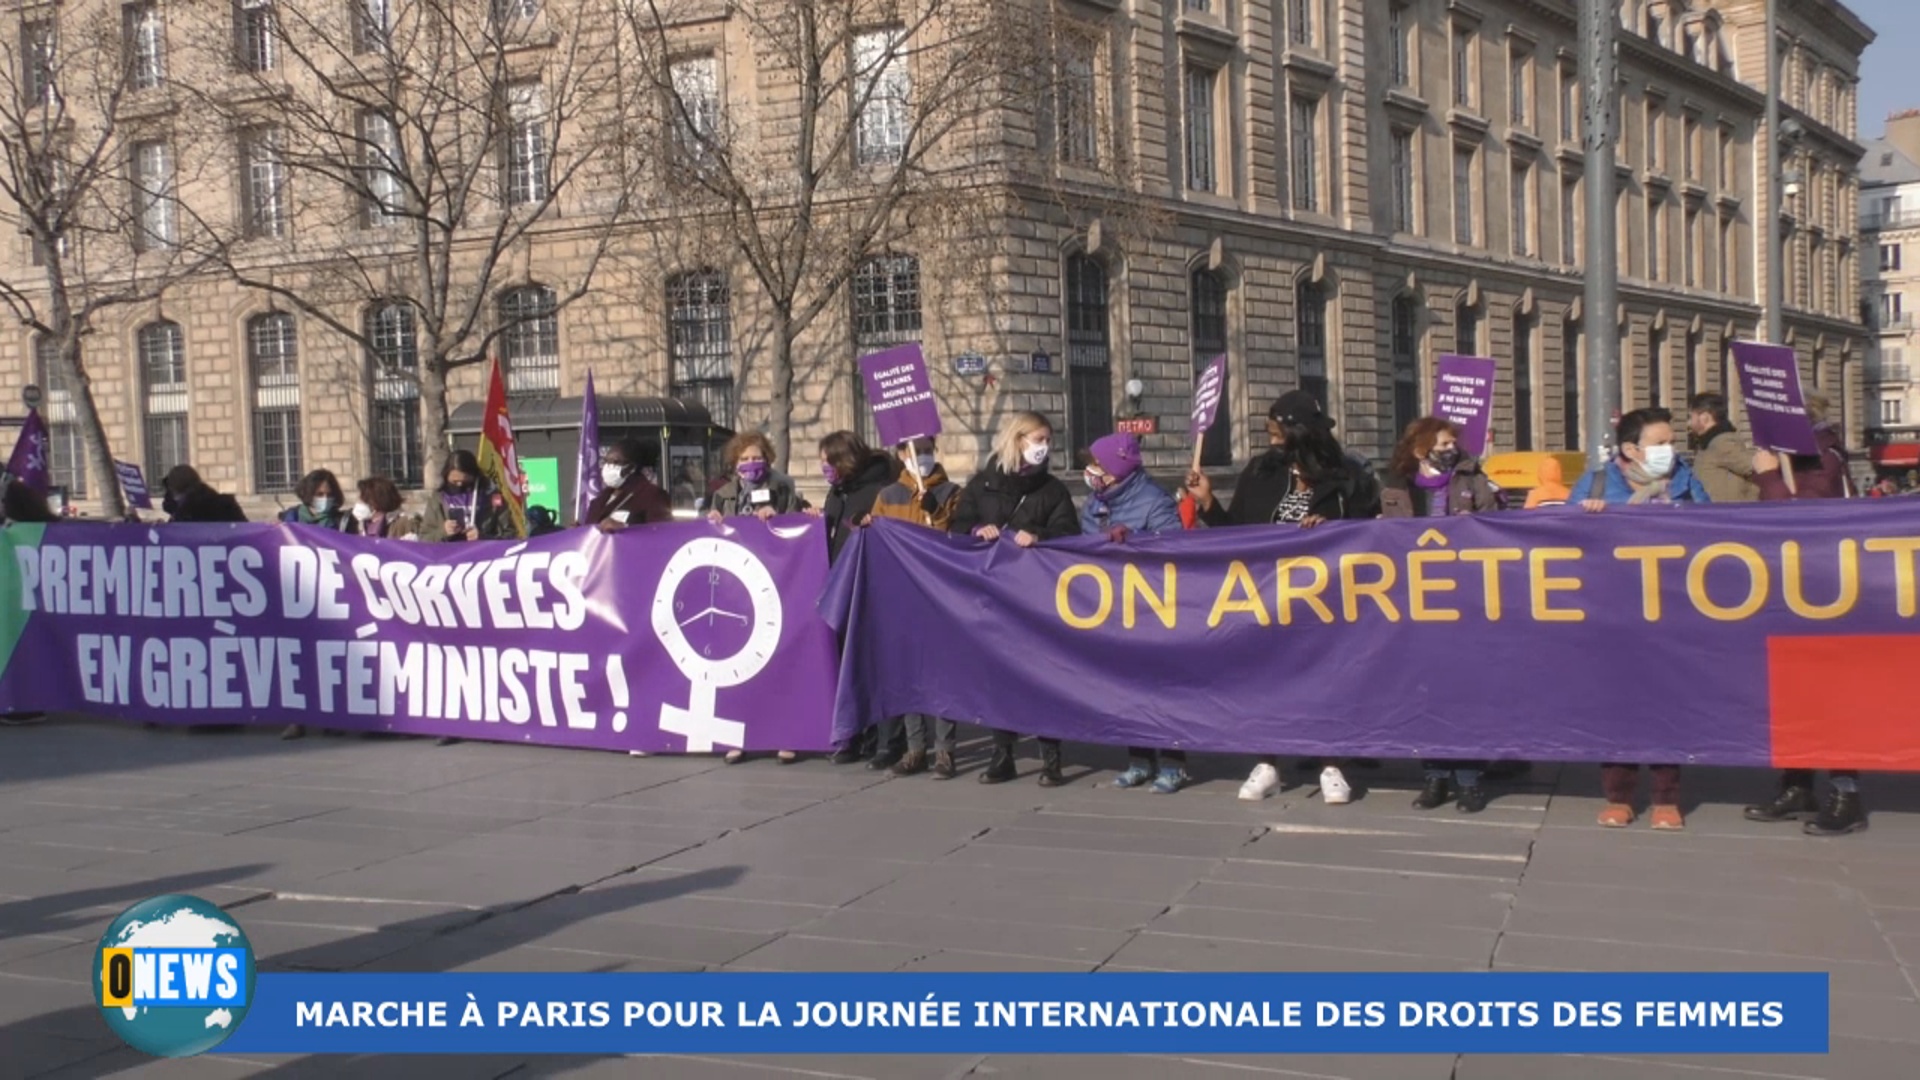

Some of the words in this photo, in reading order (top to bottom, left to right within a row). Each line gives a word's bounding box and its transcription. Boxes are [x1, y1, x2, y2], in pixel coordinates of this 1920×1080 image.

[15, 529, 267, 617] PREMIÈRES
[280, 546, 349, 619] DE
[352, 541, 588, 630] CORVÉES
[1055, 563, 1177, 629] ON
[1206, 529, 1585, 628] ARRÊTE
[1613, 537, 1920, 622] TOUT
[77, 633, 131, 705] EN
[141, 620, 306, 709] GRÈVE
[316, 622, 597, 729] FÉMINISTE
[704, 643, 711, 656] 6
